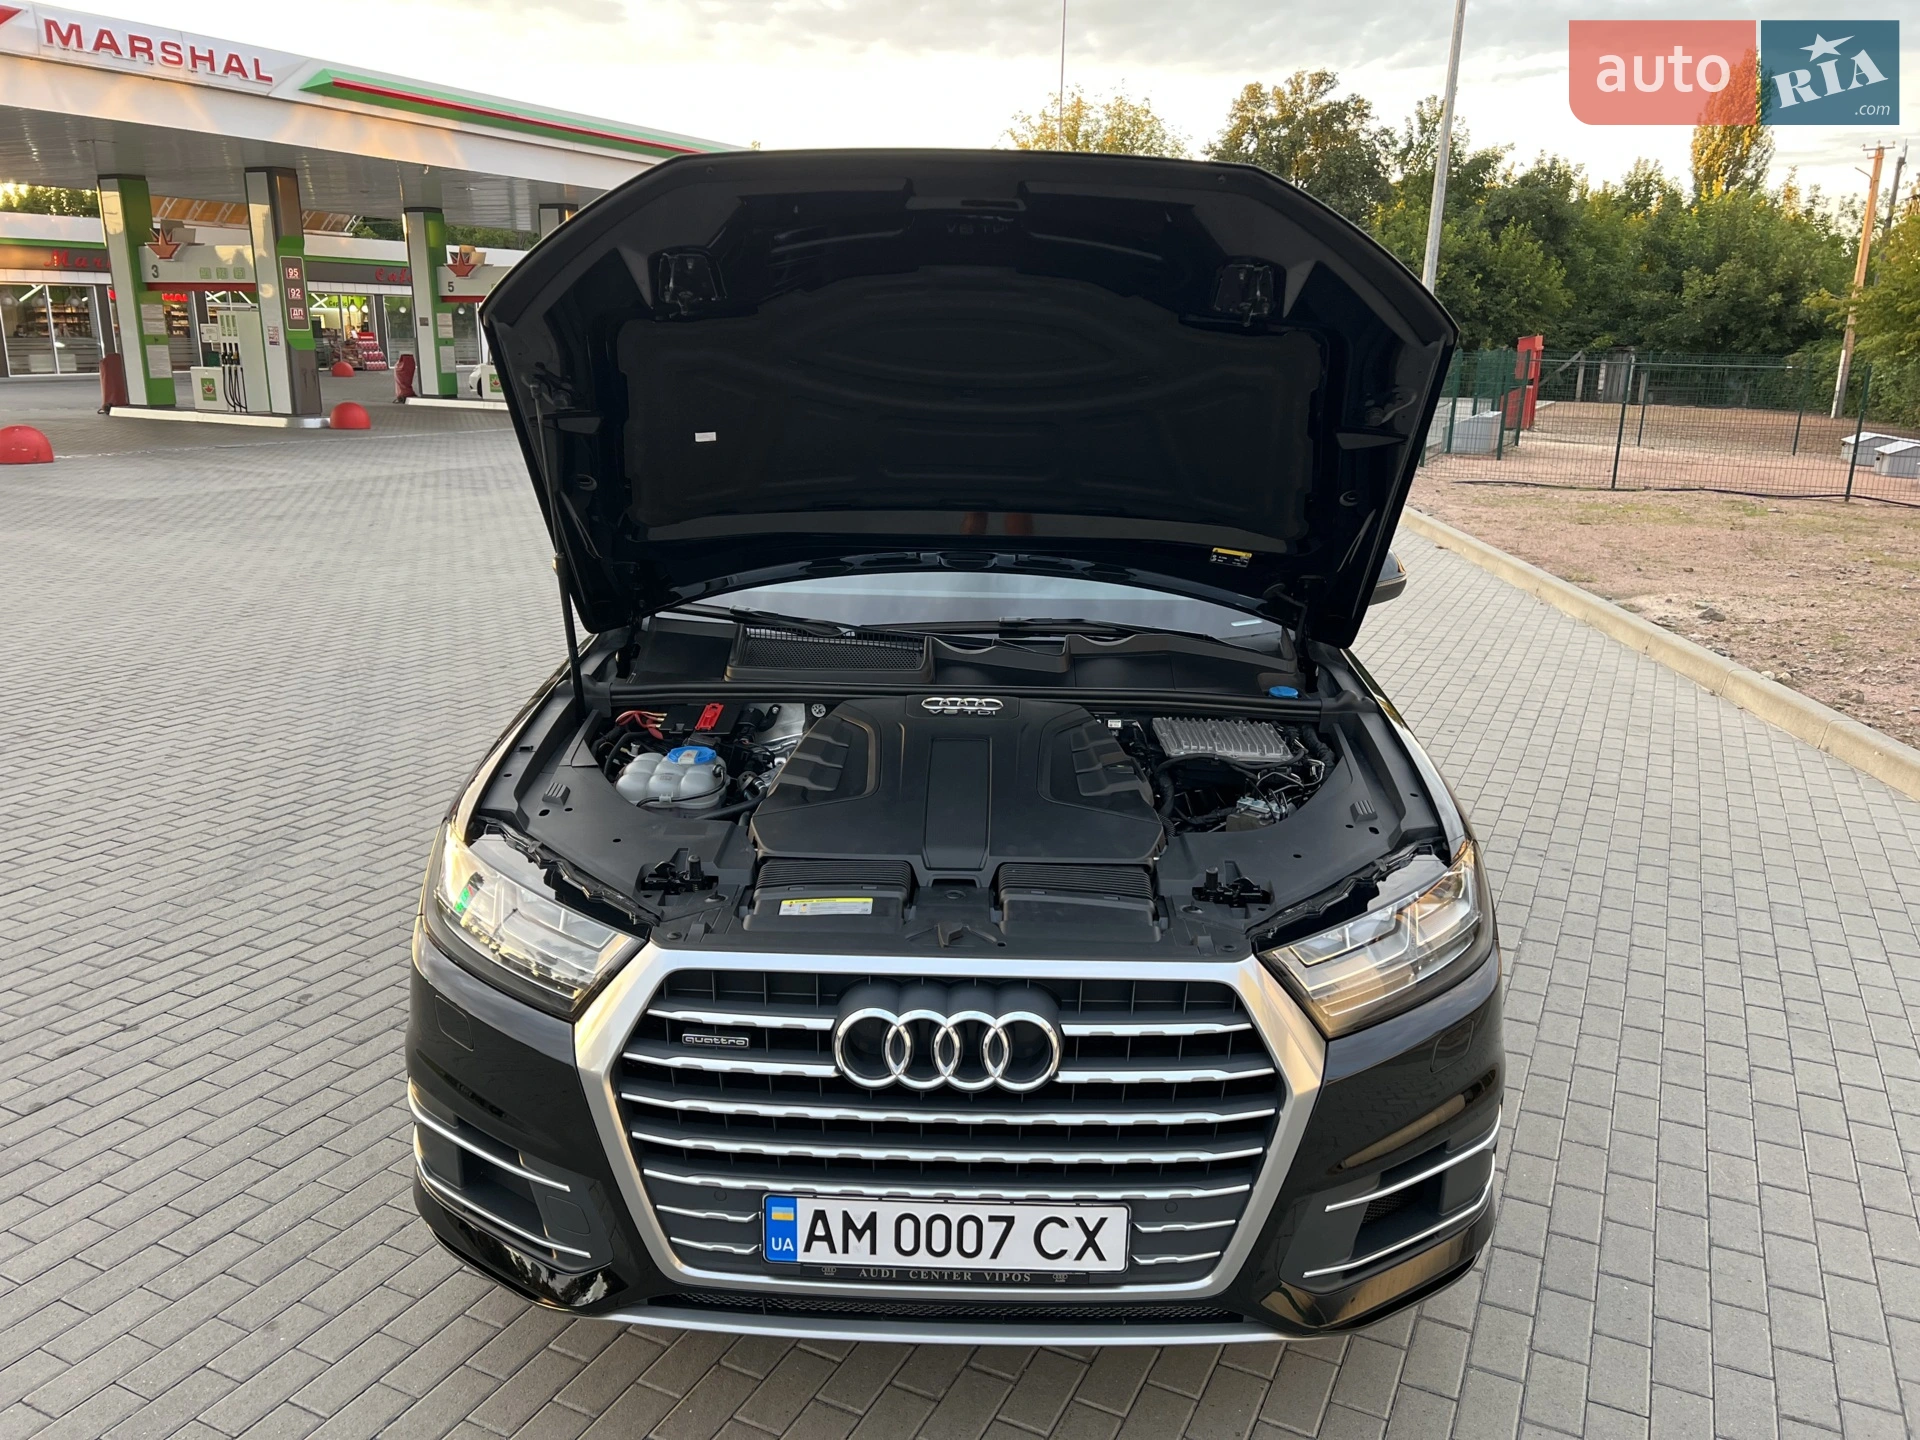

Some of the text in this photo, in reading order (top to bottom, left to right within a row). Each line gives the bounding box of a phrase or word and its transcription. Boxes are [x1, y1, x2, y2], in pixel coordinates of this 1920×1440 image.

[43, 18, 274, 84] MARSHAL
[43, 248, 111, 270] Mar
[151, 264, 159, 279] 3
[288, 268, 299, 277] 95
[290, 288, 301, 297] 92
[447, 281, 455, 293] 5
[685, 1036, 746, 1046] quattro
[803, 1209, 1108, 1262] AM 0007 CX
[771, 1236, 794, 1251] UA
[859, 1268, 1032, 1284] AUDI CENTER VIPOS
